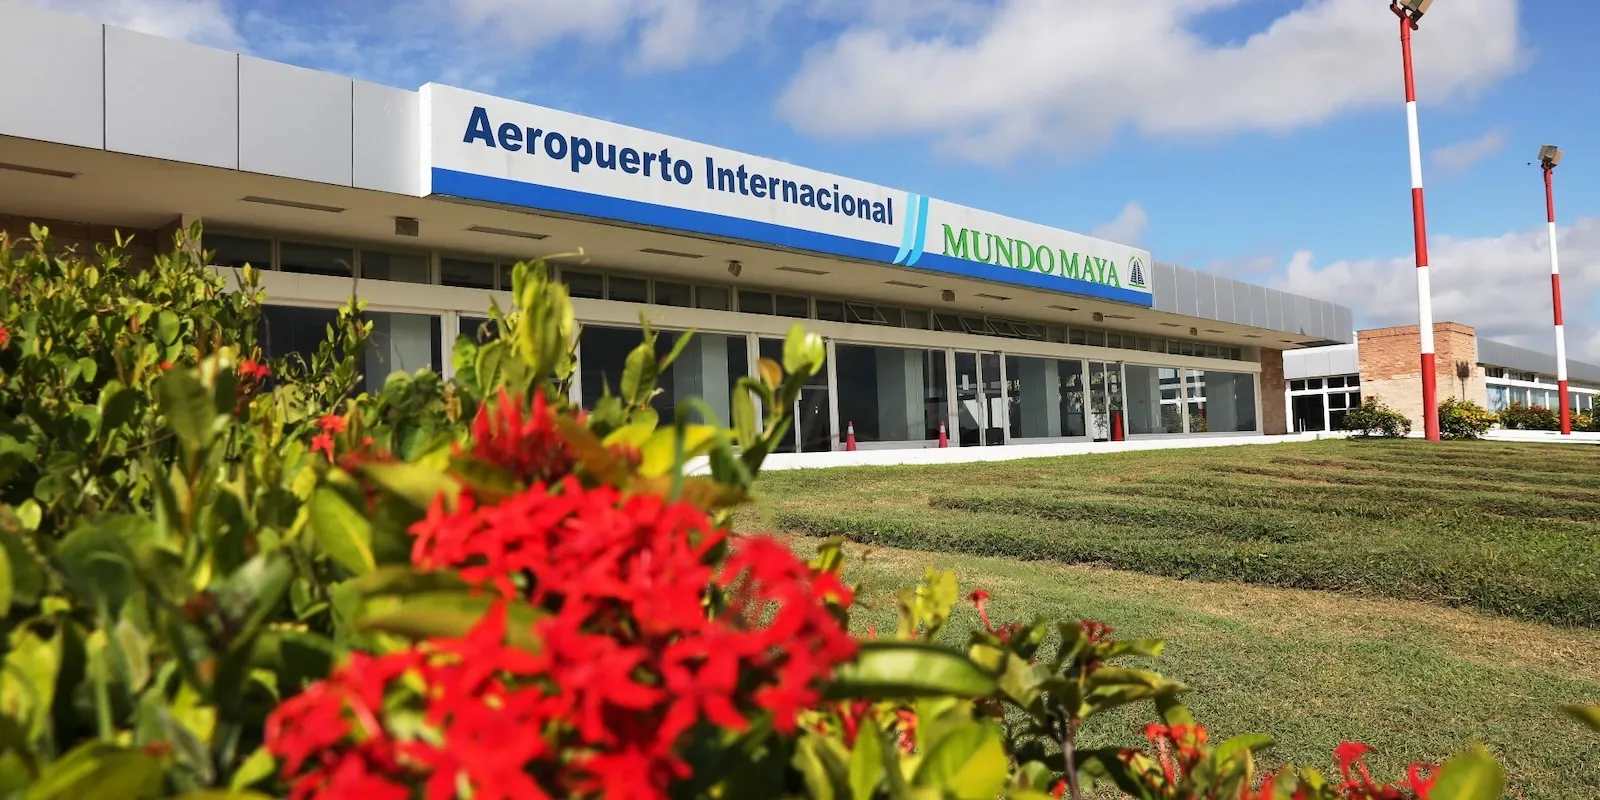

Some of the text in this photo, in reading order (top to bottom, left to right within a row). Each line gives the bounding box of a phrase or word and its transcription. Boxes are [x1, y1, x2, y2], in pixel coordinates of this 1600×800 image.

[463, 106, 894, 226] Aeropuerto Internacional
[942, 223, 1122, 288] MUNDO MAYA
